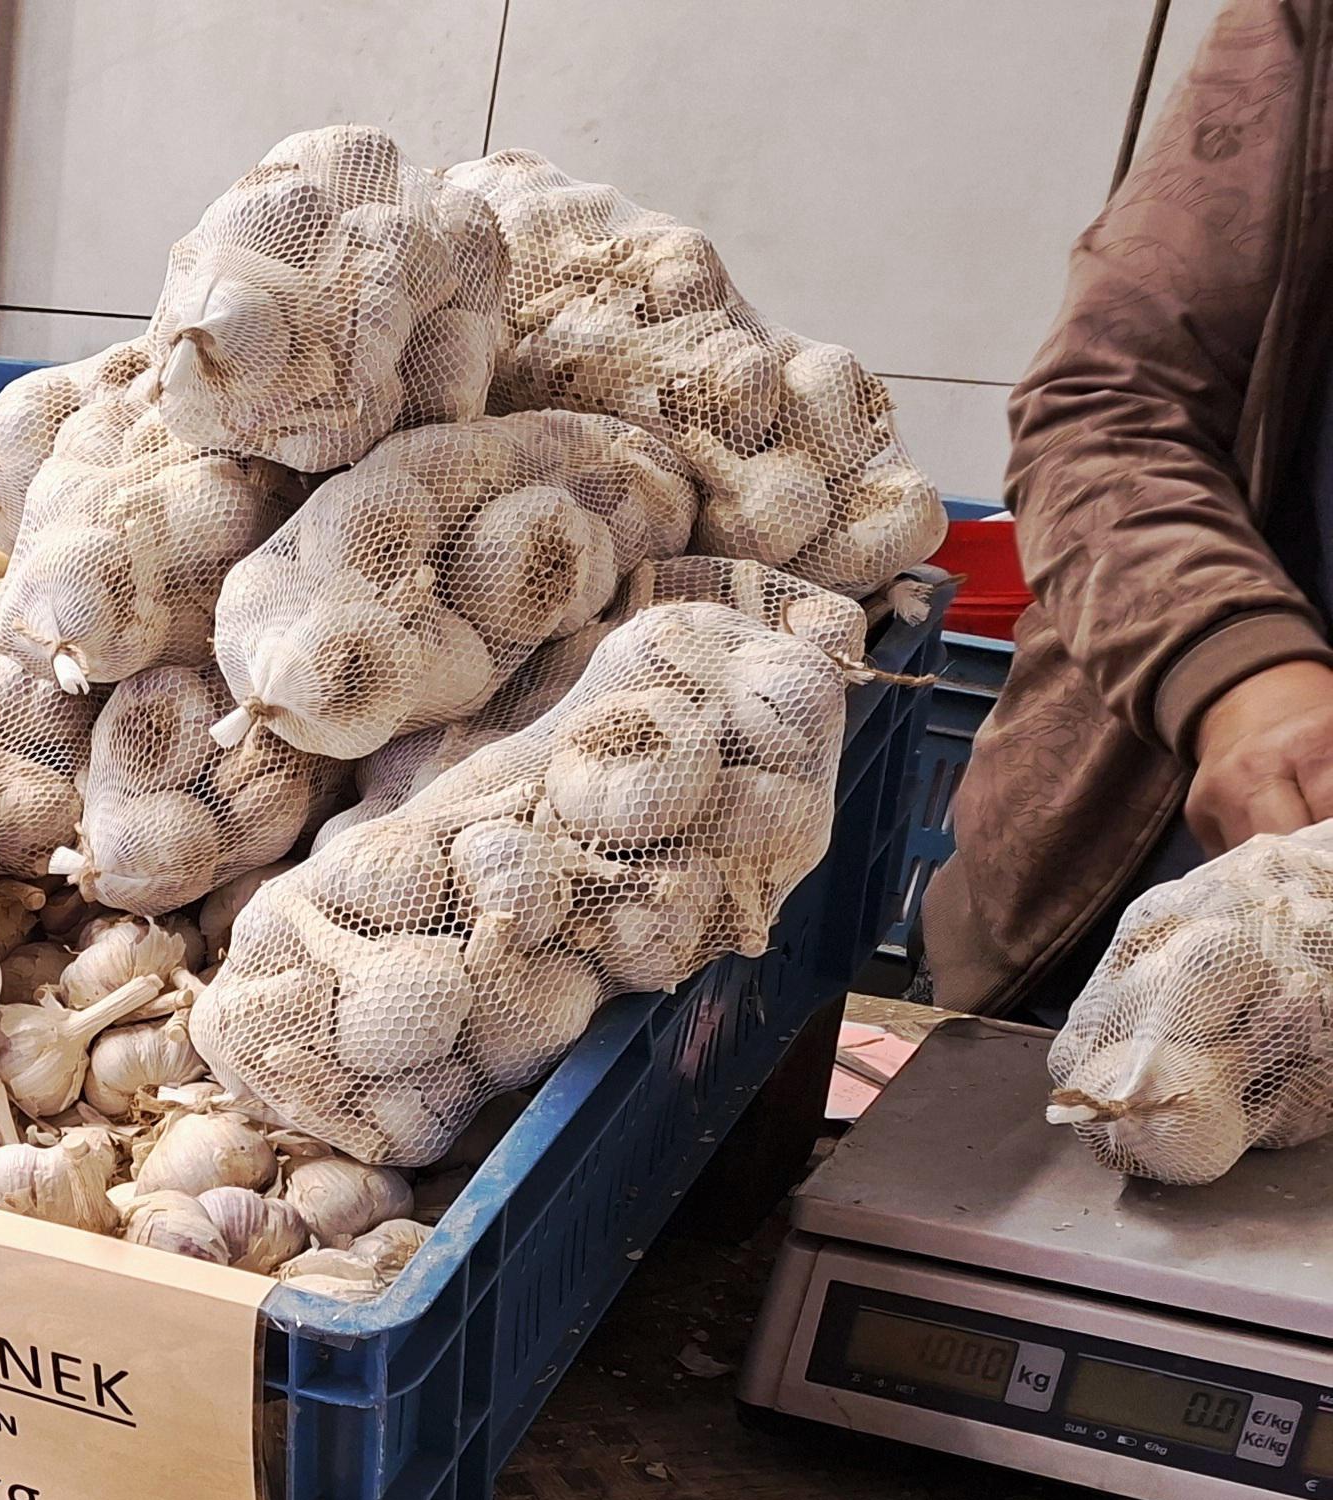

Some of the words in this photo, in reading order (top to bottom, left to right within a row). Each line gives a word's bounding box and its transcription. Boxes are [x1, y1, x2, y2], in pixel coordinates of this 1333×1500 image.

[1017, 1364, 1053, 1394] kg
[1064, 1421, 1089, 1436] SUM
[1251, 1409, 1296, 1436] €/kg
[1241, 1430, 1290, 1458] Kč/kg
